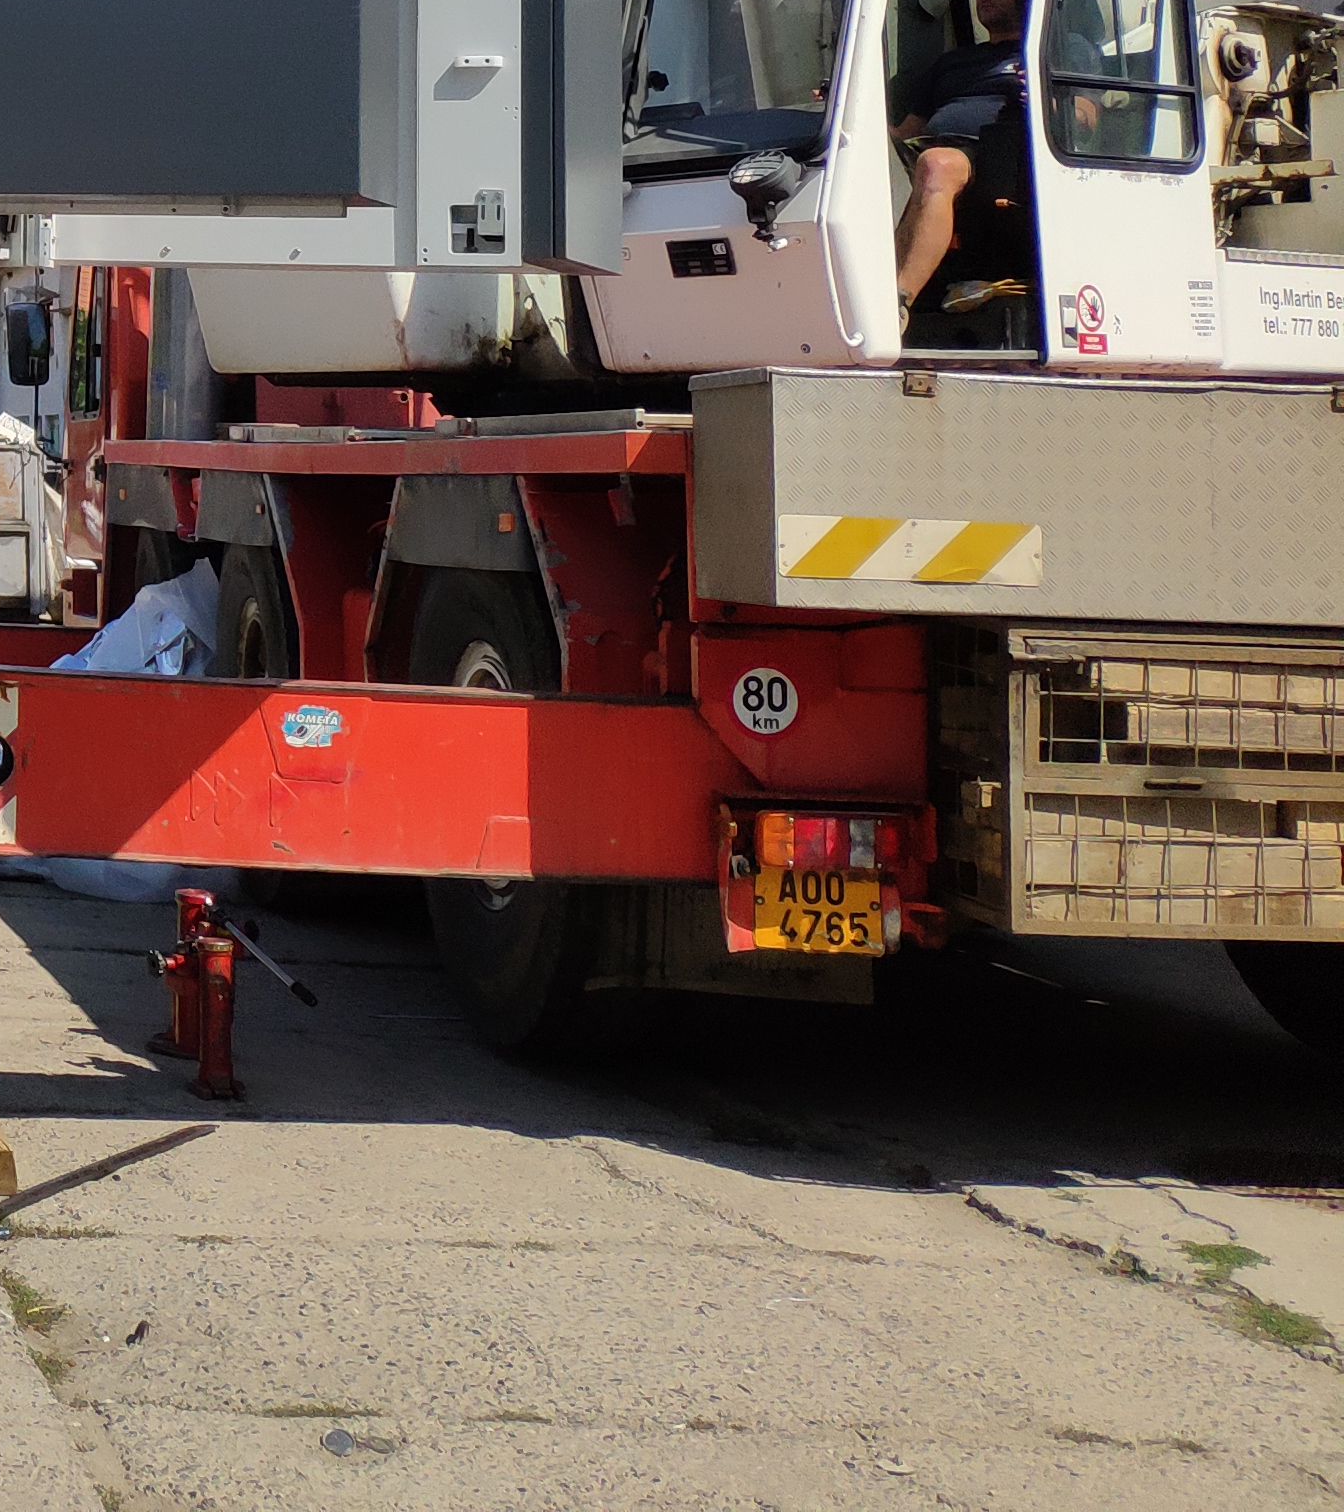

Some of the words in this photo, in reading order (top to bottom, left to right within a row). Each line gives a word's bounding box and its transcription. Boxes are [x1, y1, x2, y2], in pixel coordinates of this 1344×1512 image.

[1326, 291, 1344, 310] Be
[1291, 317, 1313, 336] 777
[1317, 319, 1340, 338] 880
[742, 675, 788, 713] 80
[287, 713, 338, 726] KOMETA
[752, 712, 780, 730] km
[779, 908, 869, 948] 4765
